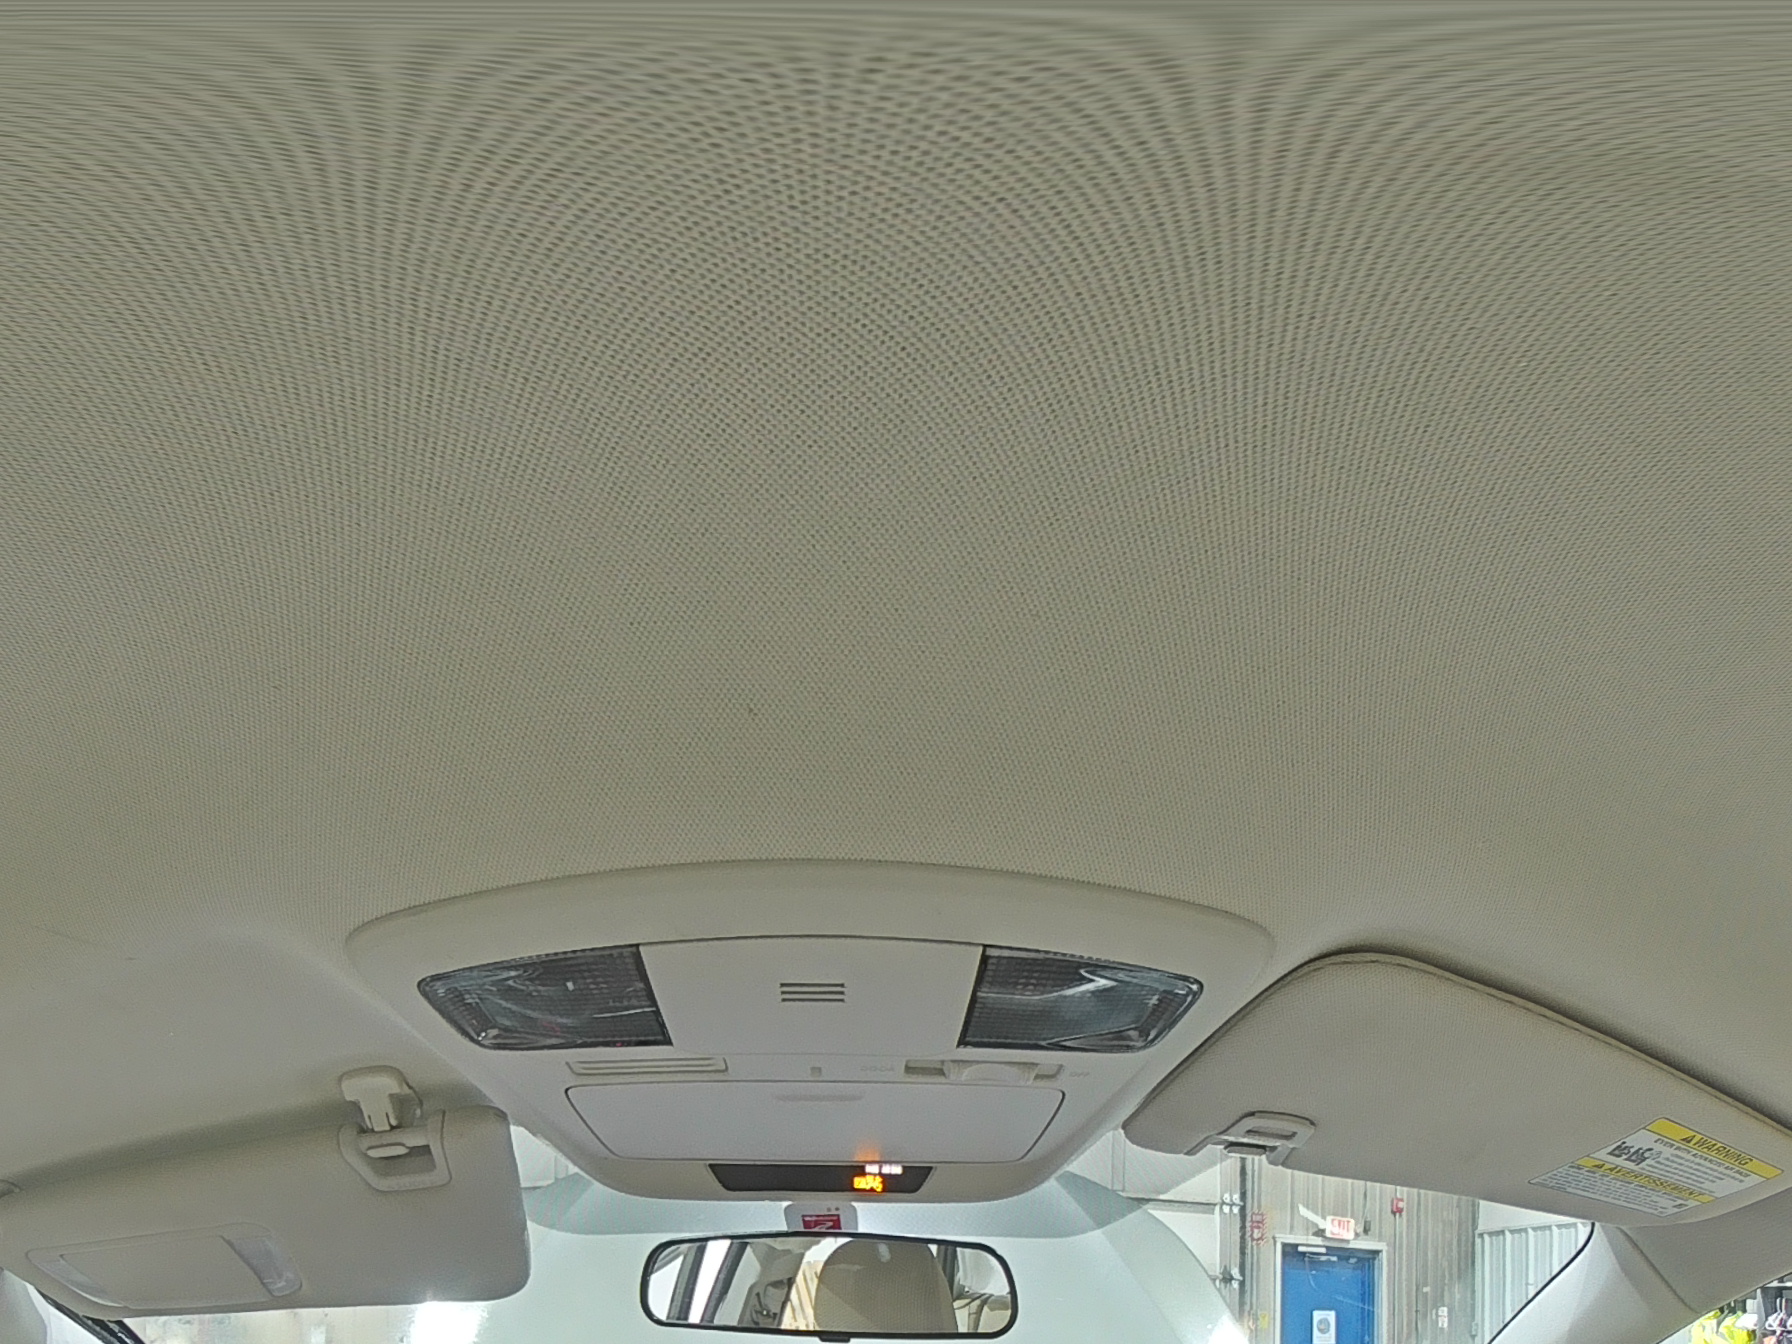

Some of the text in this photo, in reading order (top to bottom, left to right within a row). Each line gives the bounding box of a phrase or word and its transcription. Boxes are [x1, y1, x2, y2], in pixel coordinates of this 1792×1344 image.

[1692, 1136, 1754, 1167] WARNING
[1607, 1165, 1706, 1200] AVERTISSEMENT
[1330, 1217, 1352, 1236] EXIT
